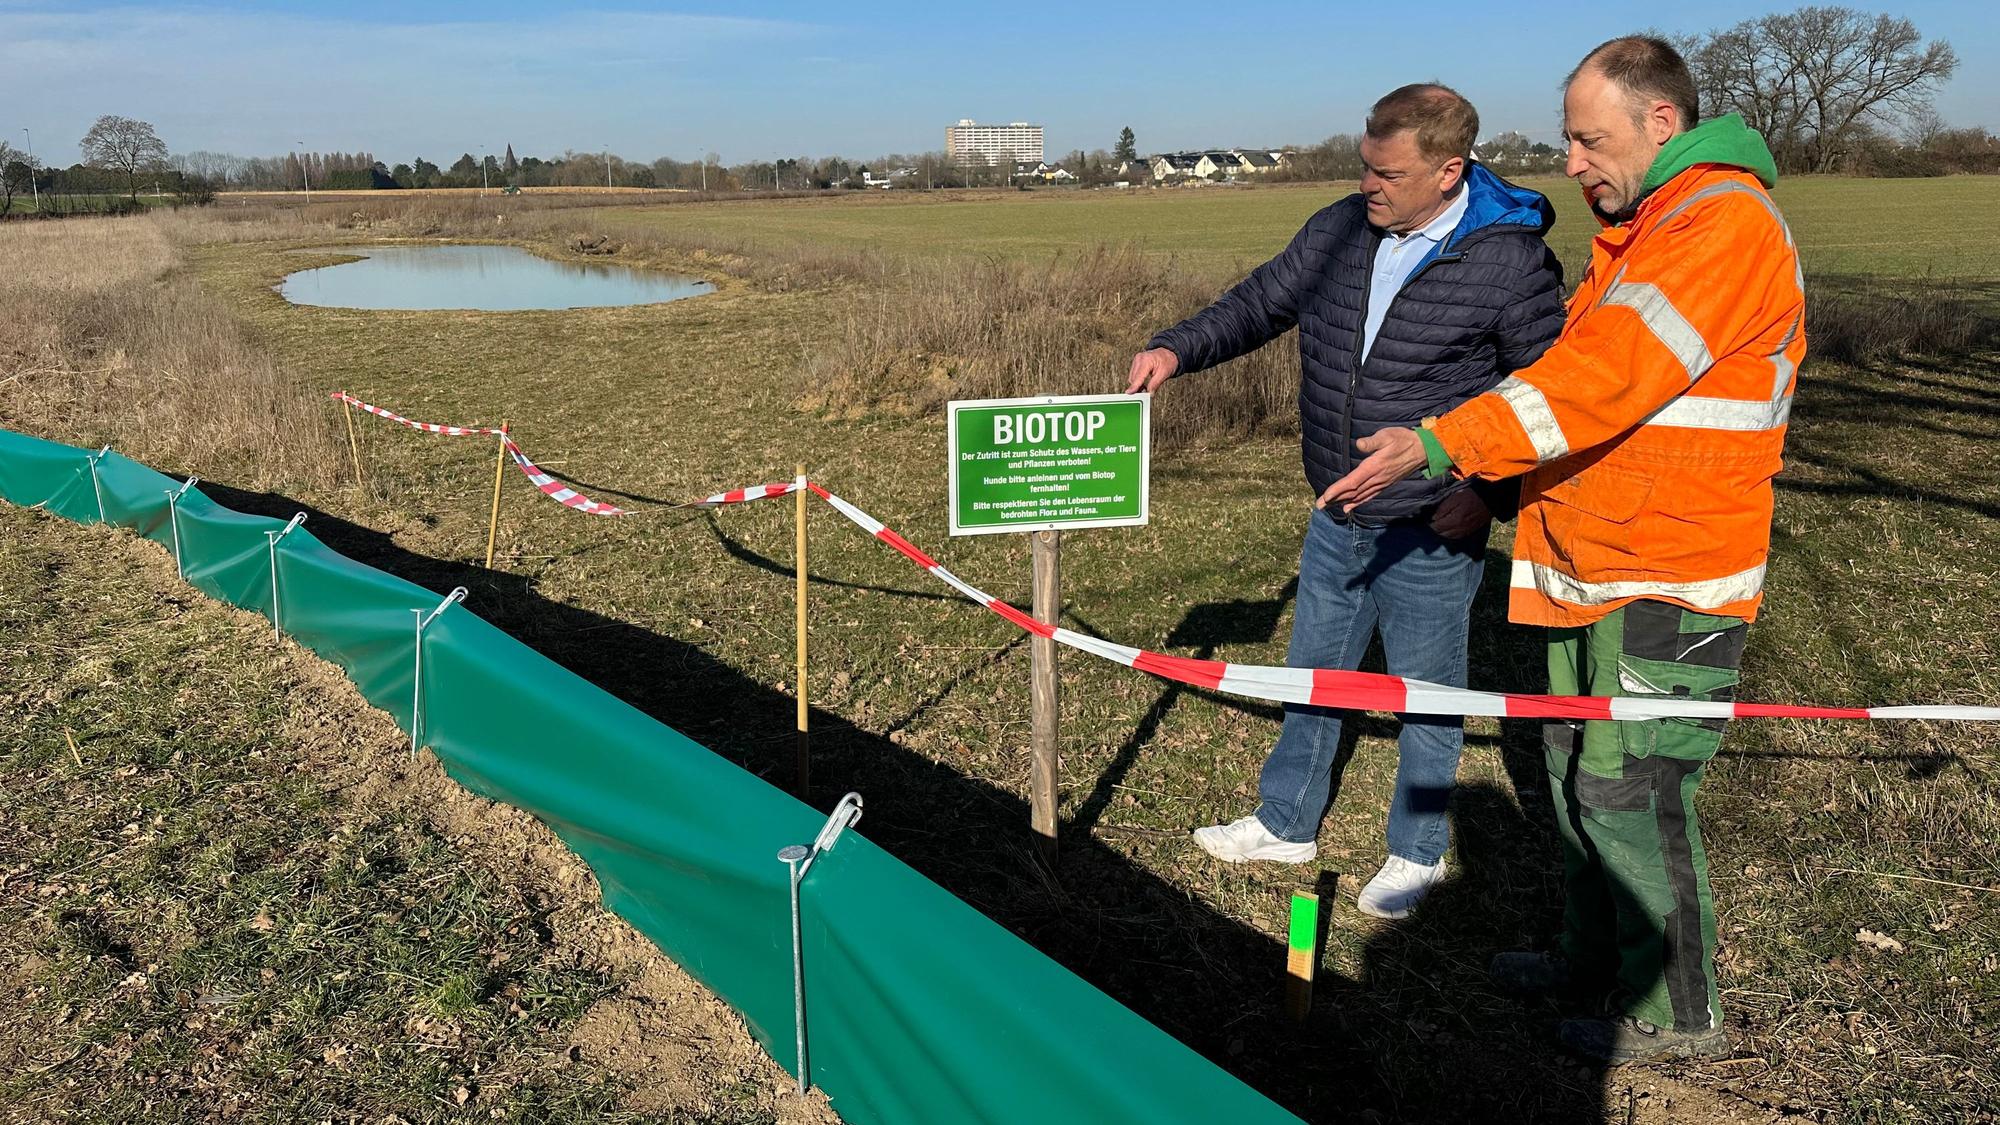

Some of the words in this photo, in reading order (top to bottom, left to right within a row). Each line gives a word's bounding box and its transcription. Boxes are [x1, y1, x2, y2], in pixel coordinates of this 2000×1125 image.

[994, 411, 1105, 444] BIOTOP
[1071, 447, 1103, 455] Wassers,
[1024, 459, 1055, 468] Pflanzen
[1057, 458, 1091, 466] verboten!
[1027, 474, 1058, 483] anleinen
[1092, 471, 1115, 481] Biotop
[1031, 484, 1069, 492] fernhalten!
[992, 499, 1037, 509] respektieren
[1068, 496, 1111, 504] Lebensraum
[1001, 511, 1037, 519] bedrohten
